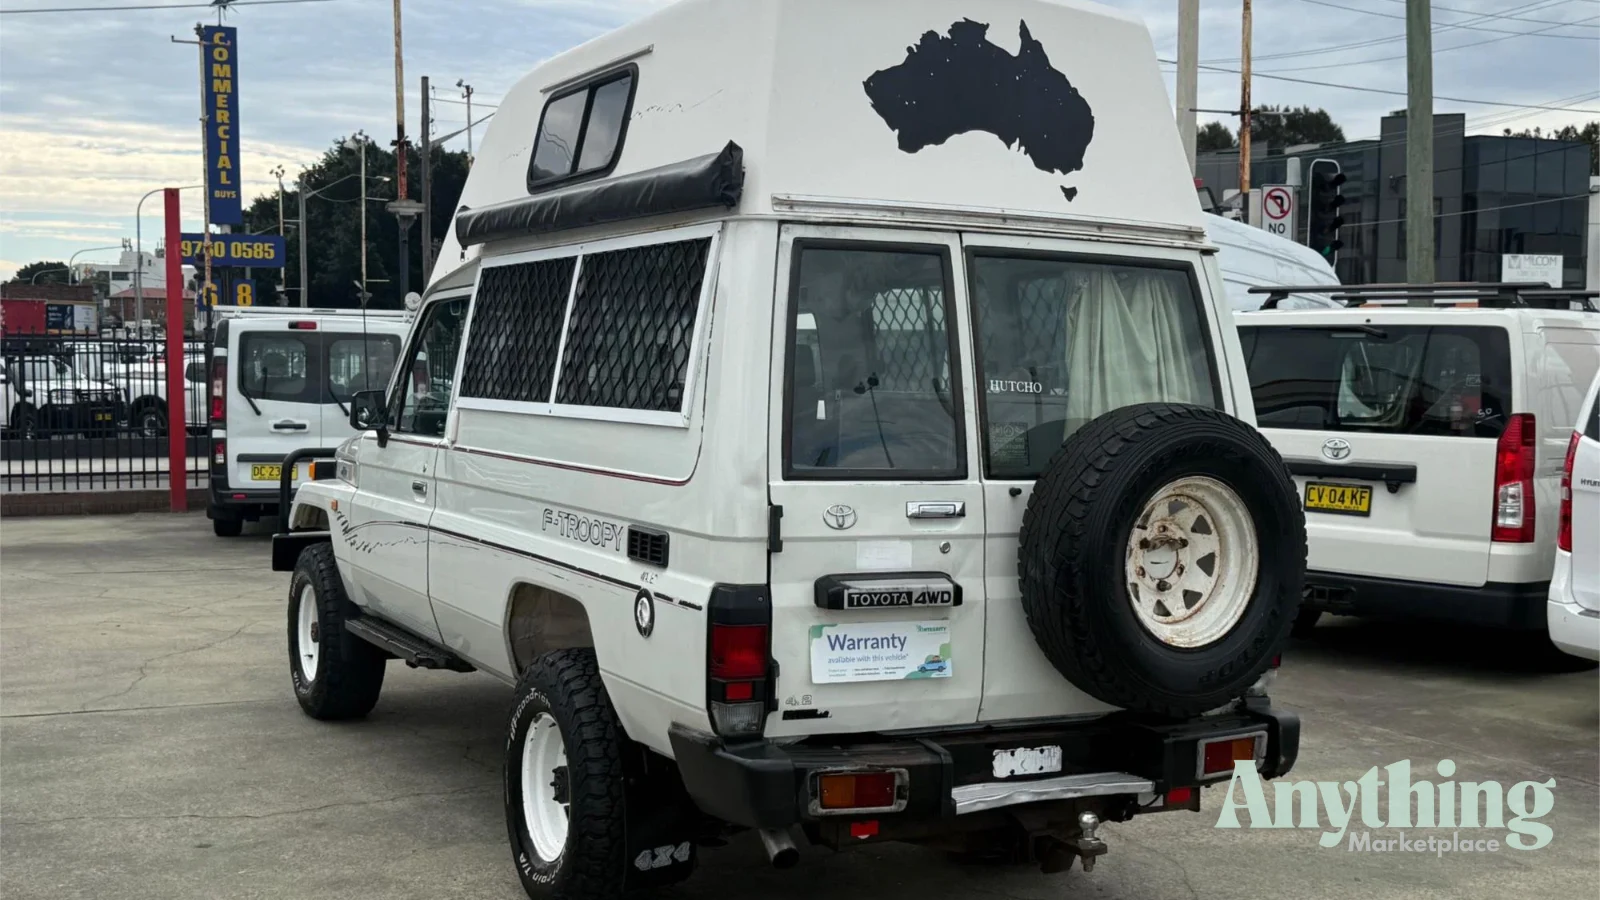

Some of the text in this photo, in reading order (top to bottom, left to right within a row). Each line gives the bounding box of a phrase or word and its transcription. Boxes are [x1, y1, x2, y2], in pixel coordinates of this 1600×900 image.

[213, 32, 231, 184] COMMERCIAL
[214, 190, 237, 198] BUYS
[1269, 223, 1286, 234] NO
[231, 242, 275, 259] 0585
[990, 379, 1042, 393] HUTCHO
[542, 508, 623, 551] F-TROOPY
[851, 591, 951, 606] TOYOTA 4WD
[827, 633, 907, 651] Warranty
[828, 656, 855, 664] available
[785, 694, 812, 706] 4.2
